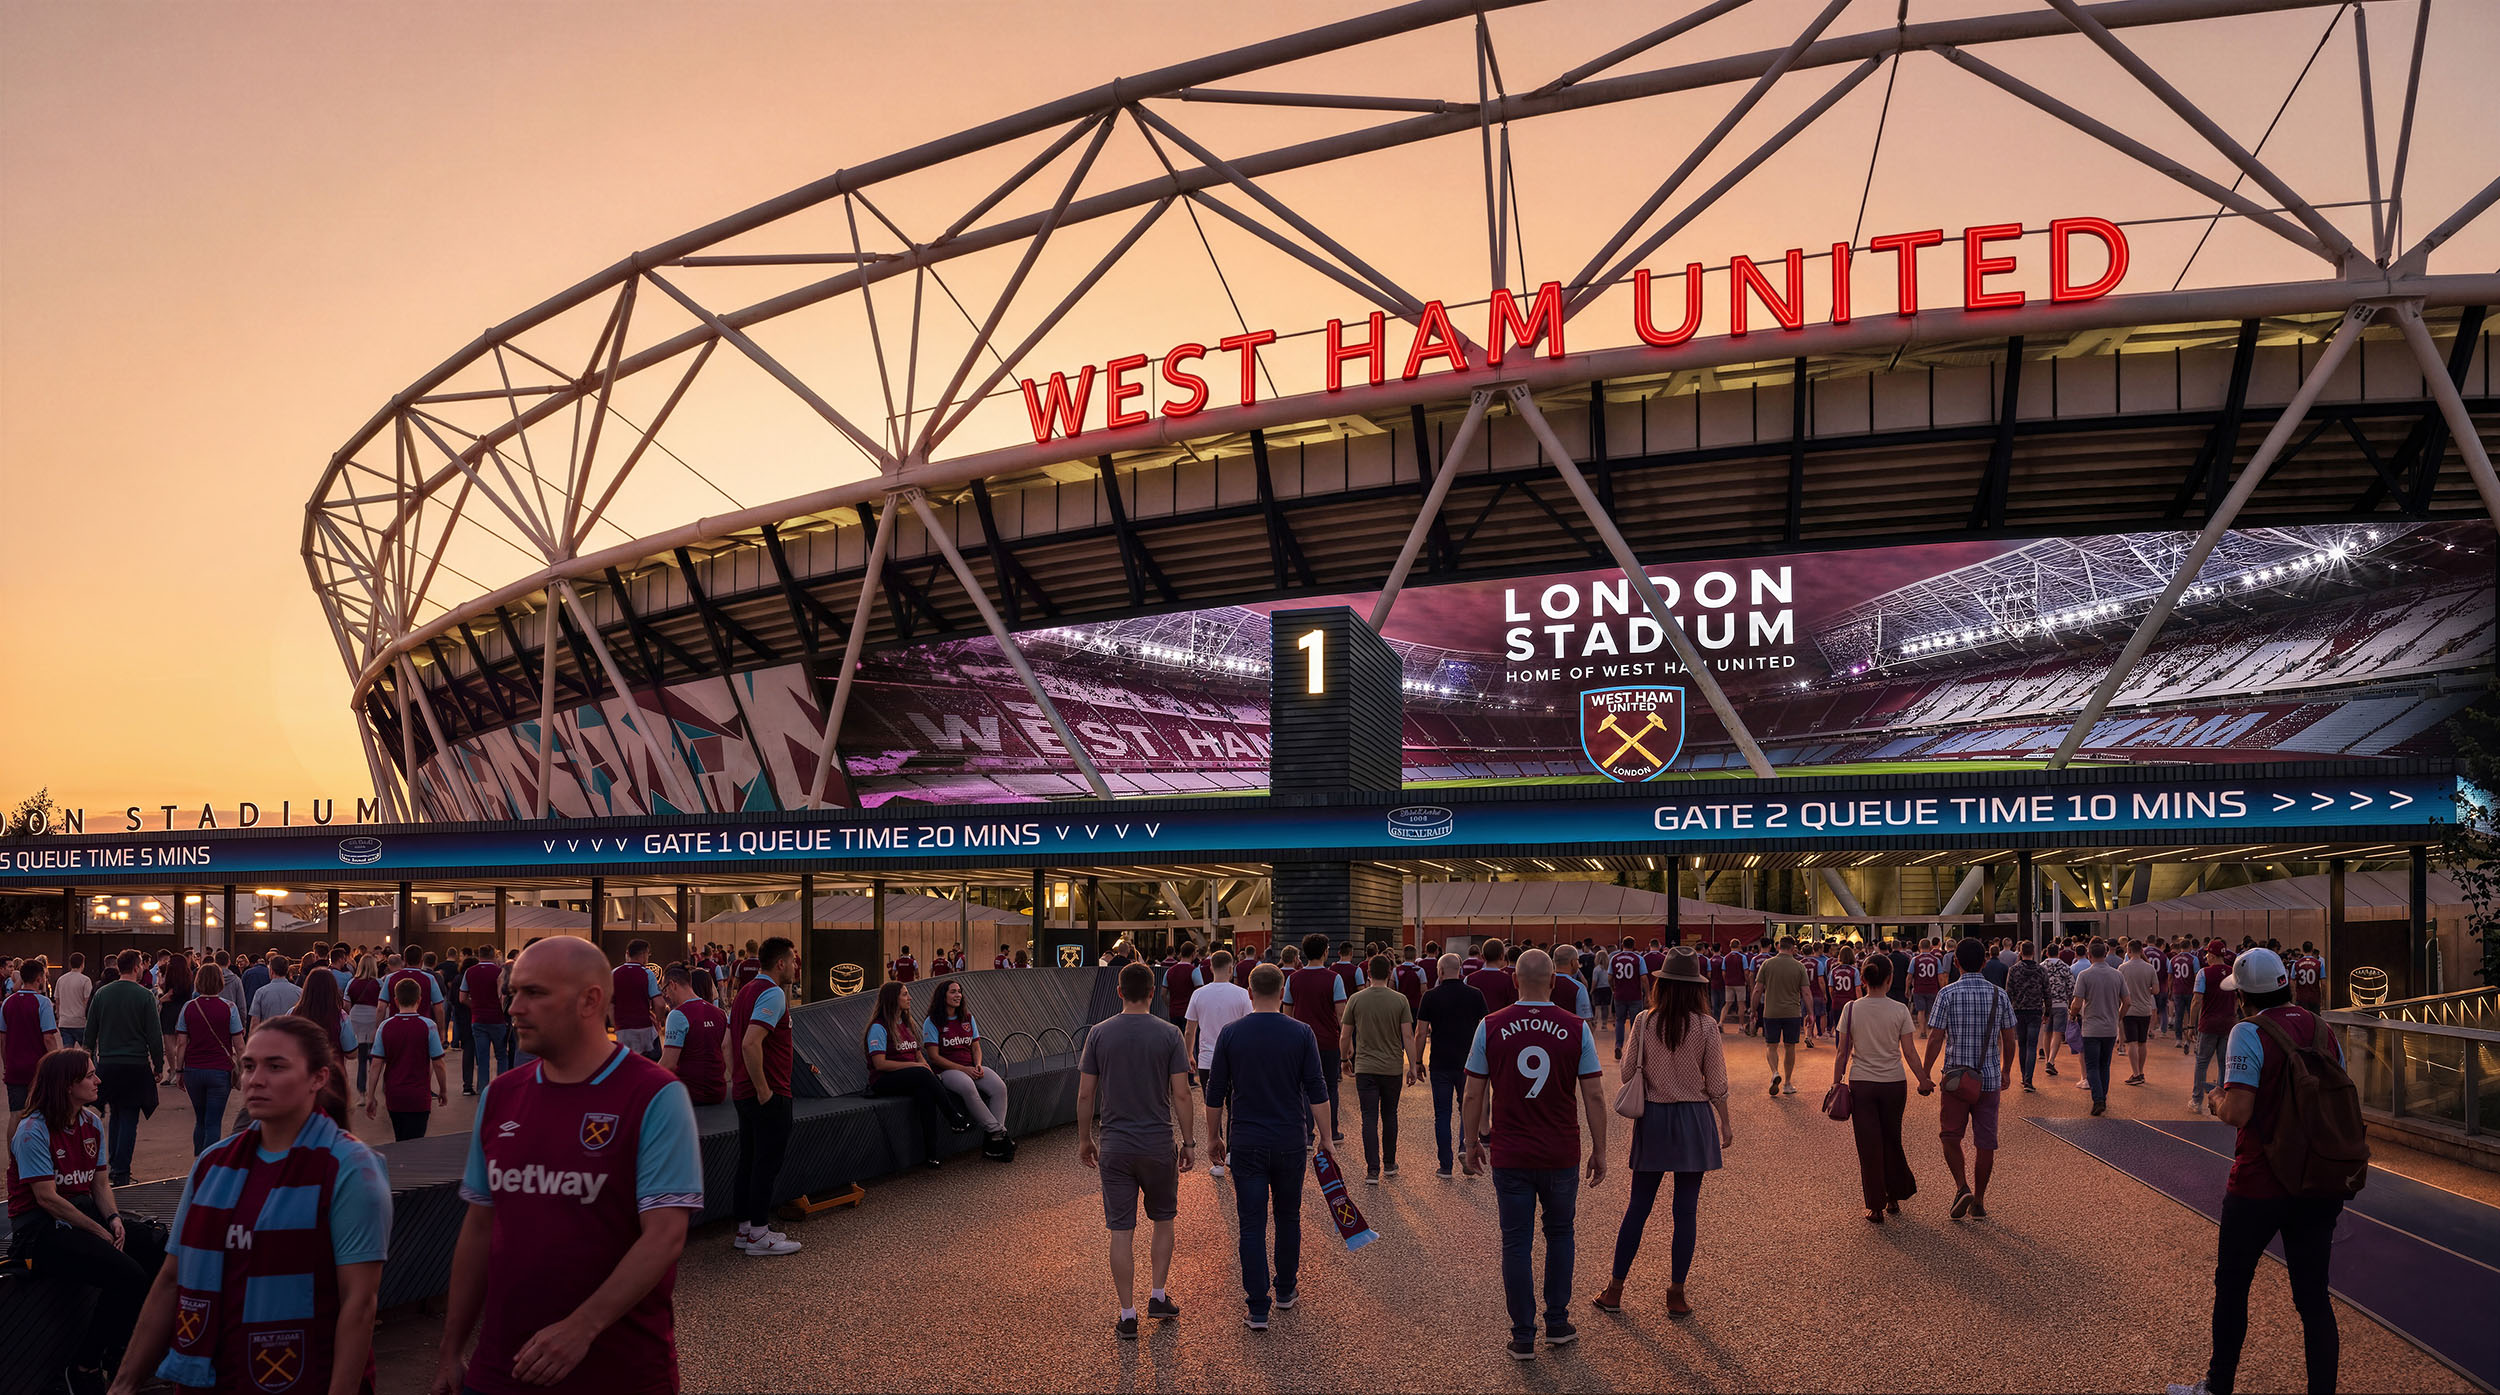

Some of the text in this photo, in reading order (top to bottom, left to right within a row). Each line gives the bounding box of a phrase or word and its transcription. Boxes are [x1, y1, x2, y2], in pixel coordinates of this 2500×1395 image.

[1021, 217, 2129, 443] WEST HAM UNITED
[1505, 566, 1793, 622] LONDON
[1298, 629, 1324, 694] 1
[1506, 655, 1796, 683] HOME OF WEST HA UNITED
[1591, 691, 1674, 707] WEST HAM
[1607, 702, 1657, 713] UNITED
[905, 712, 1160, 757] WEST
[1612, 766, 1652, 777] LONDON
[126, 796, 382, 832] STADIUM
[1654, 790, 2247, 831] GATE 2 QUEUE TIME 10 MINS
[644, 823, 1041, 856] GATE 1 QUEUE TIME 20 MINS
[16, 849, 82, 872] QUEUE
[87, 848, 135, 868] TIME
[141, 847, 153, 867] 5
[158, 845, 211, 866] MINS
[1615, 962, 1634, 980] 30
[1919, 962, 1936, 978] 30
[2173, 962, 2189, 979] 30
[2298, 968, 2316, 985] 30
[1834, 975, 1852, 992] 30
[943, 1035, 974, 1047] betway
[1500, 1018, 1569, 1041] ANTONIO
[1517, 1045, 1551, 1099] 9
[54, 1168, 96, 1186] betwa
[488, 1159, 609, 1205] betway
